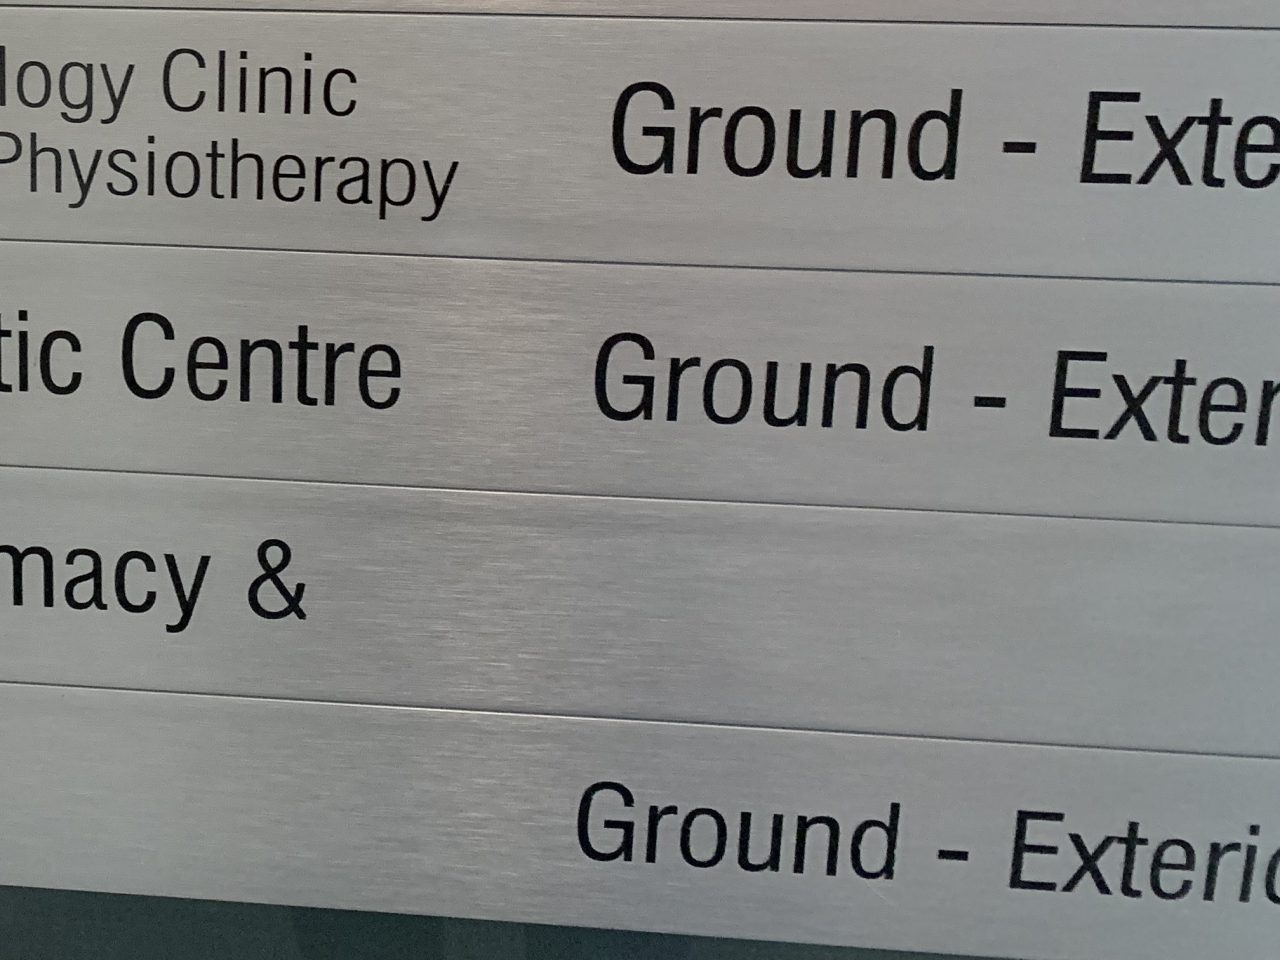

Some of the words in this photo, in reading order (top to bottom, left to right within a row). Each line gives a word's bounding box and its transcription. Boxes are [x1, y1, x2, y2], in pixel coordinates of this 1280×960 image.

[162, 48, 357, 117] Clinic
[611, 81, 963, 182] Ground
[1002, 141, 1037, 154] -
[121, 312, 402, 410] Centre
[594, 331, 935, 432] Ground
[973, 395, 1007, 409] -
[247, 538, 307, 621] &
[576, 780, 901, 881] Ground
[937, 849, 970, 862] -
